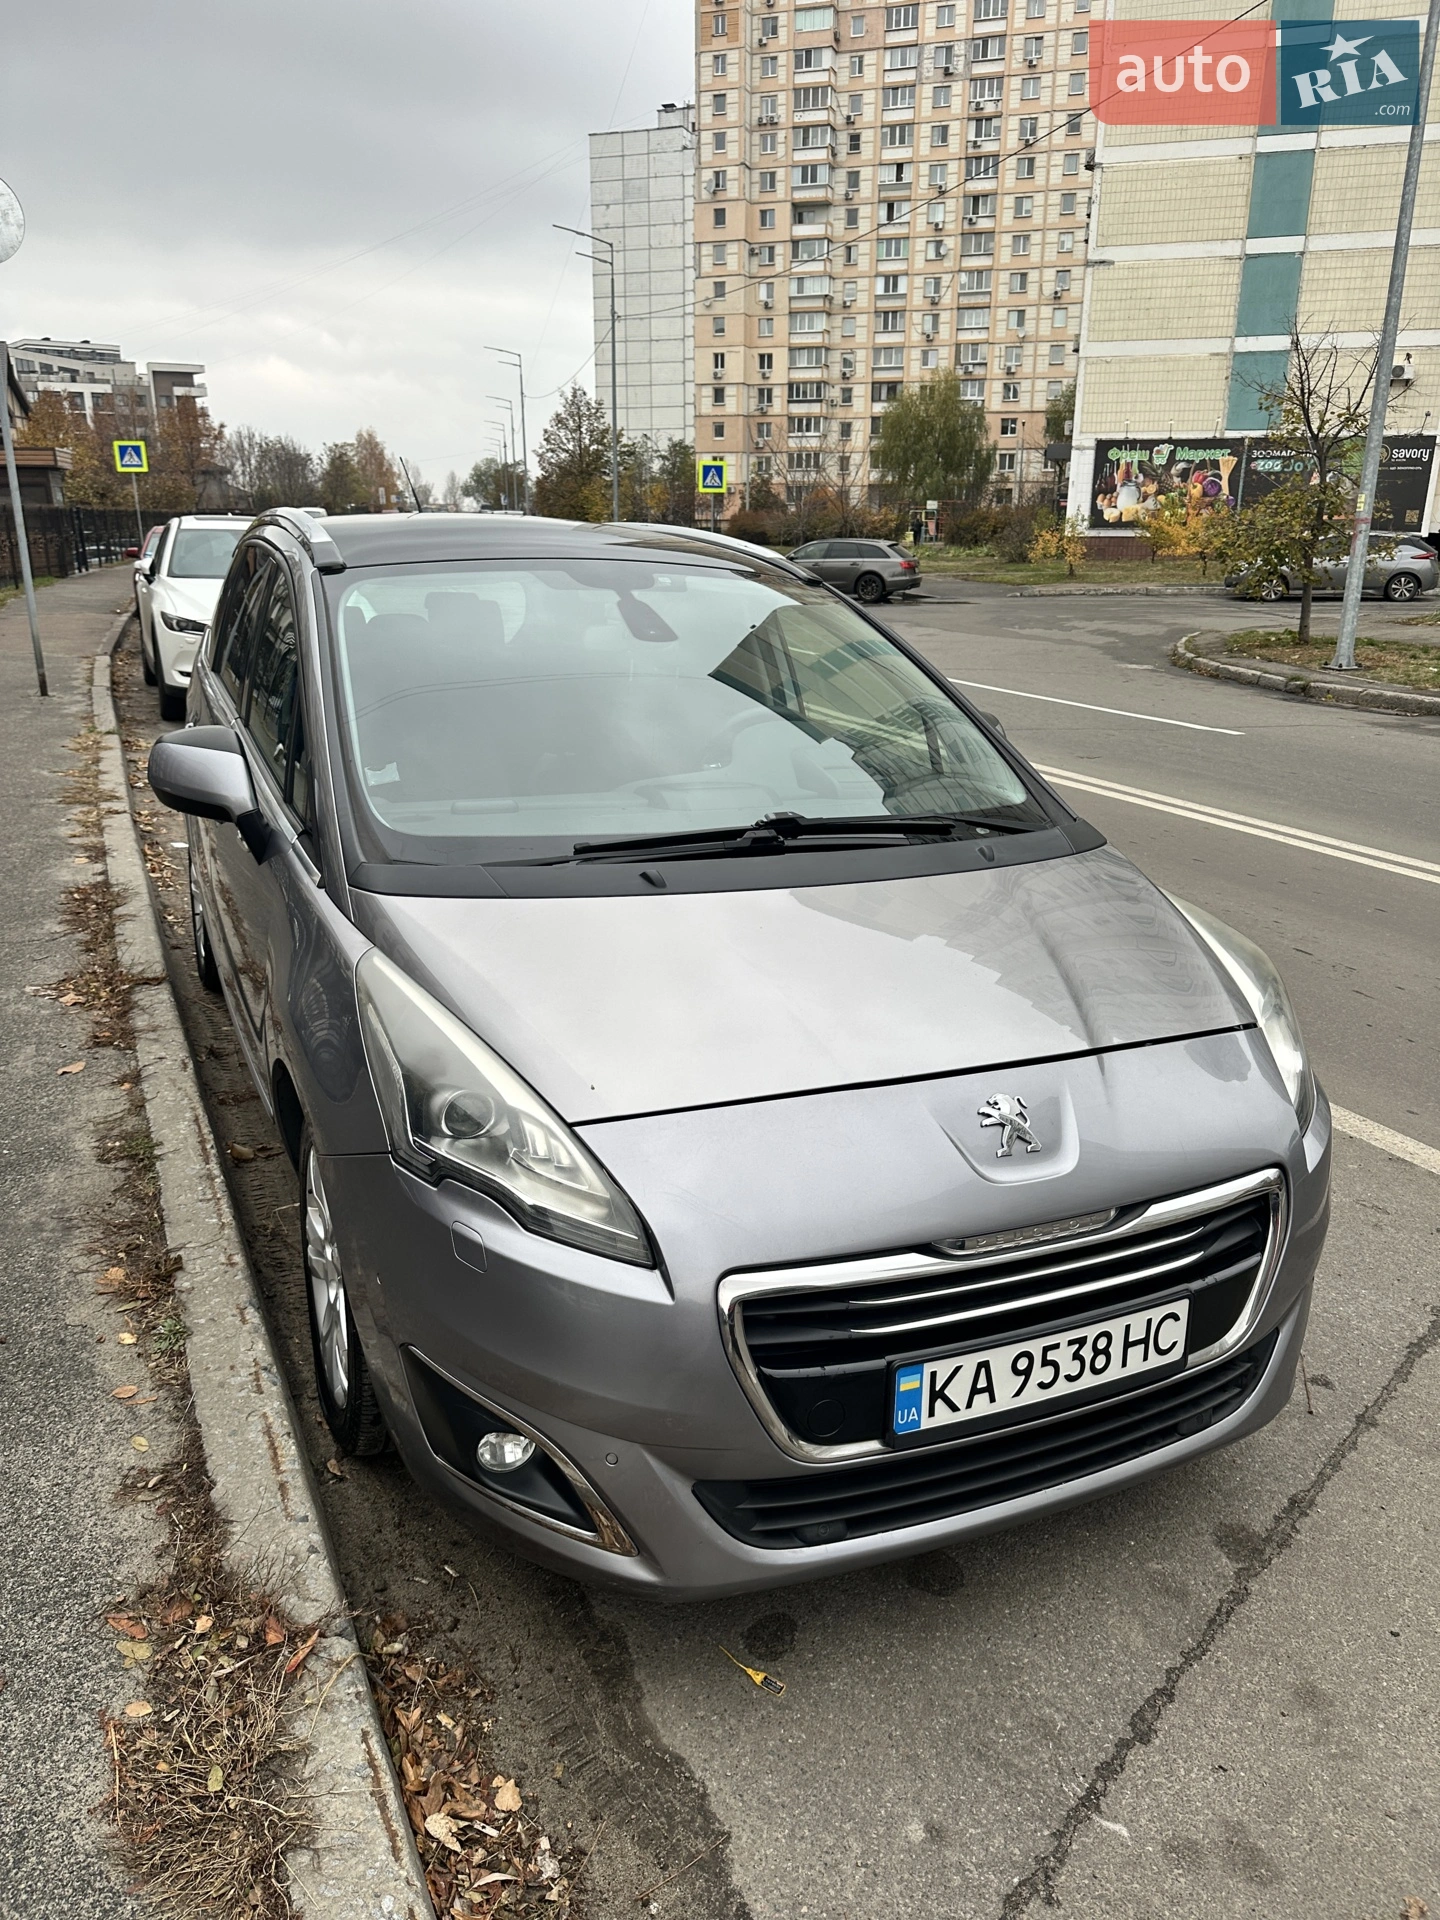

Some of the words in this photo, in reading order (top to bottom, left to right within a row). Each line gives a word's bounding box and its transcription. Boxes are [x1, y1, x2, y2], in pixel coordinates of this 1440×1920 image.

[1108, 447, 1149, 460] Фреш
[1175, 447, 1231, 461] Маркет
[1392, 448, 1430, 461] savory
[927, 1359, 997, 1418] KA
[1010, 1330, 1113, 1399] 9538
[1120, 1311, 1181, 1369] HC
[897, 1407, 919, 1425] UA
